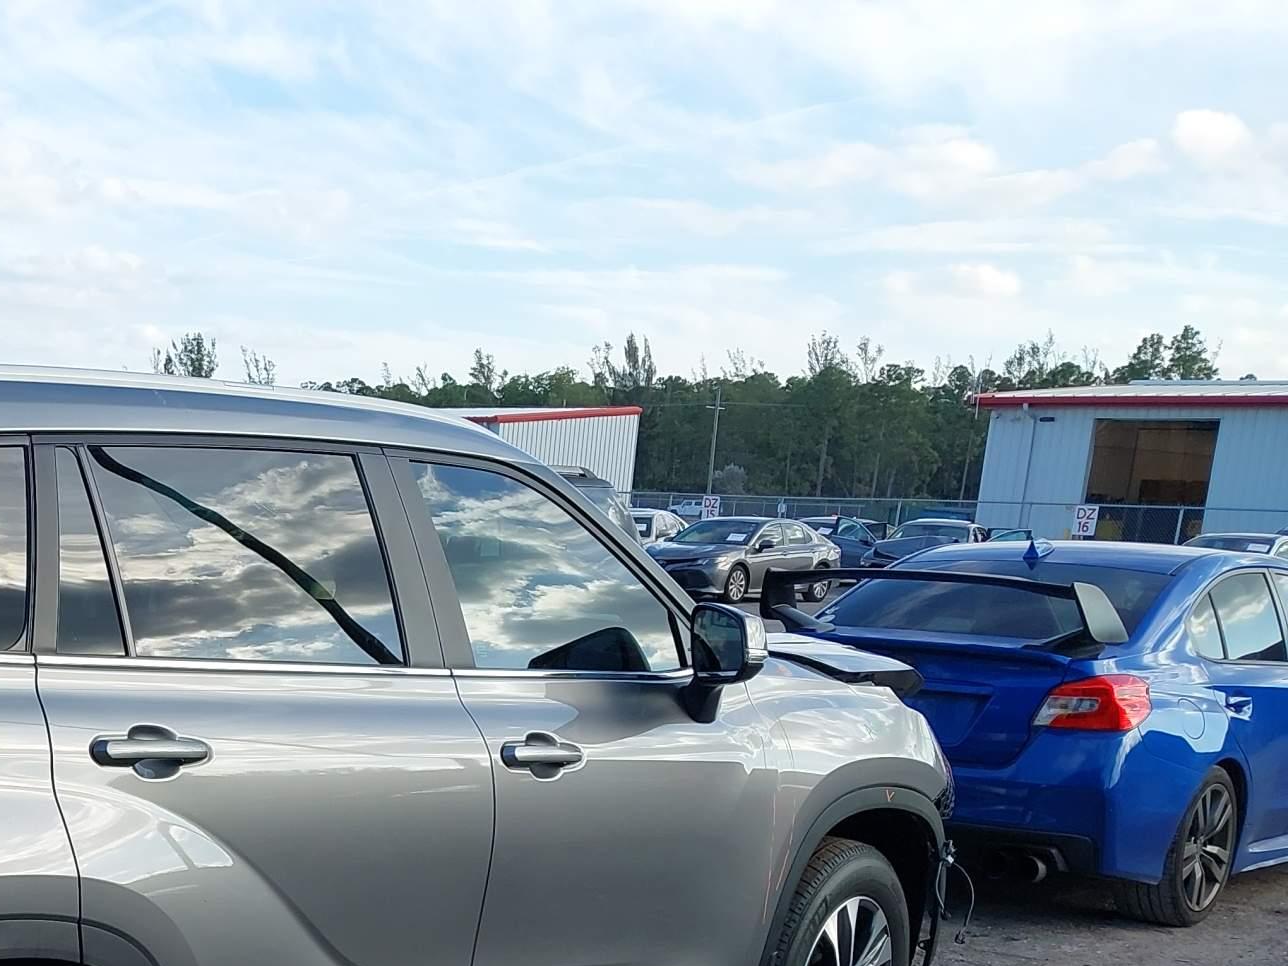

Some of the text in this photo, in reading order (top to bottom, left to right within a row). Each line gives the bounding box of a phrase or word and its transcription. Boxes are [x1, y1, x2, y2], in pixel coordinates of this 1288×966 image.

[703, 498, 719, 509] DZ
[1076, 507, 1097, 520] DZ
[1077, 521, 1090, 533] 16
